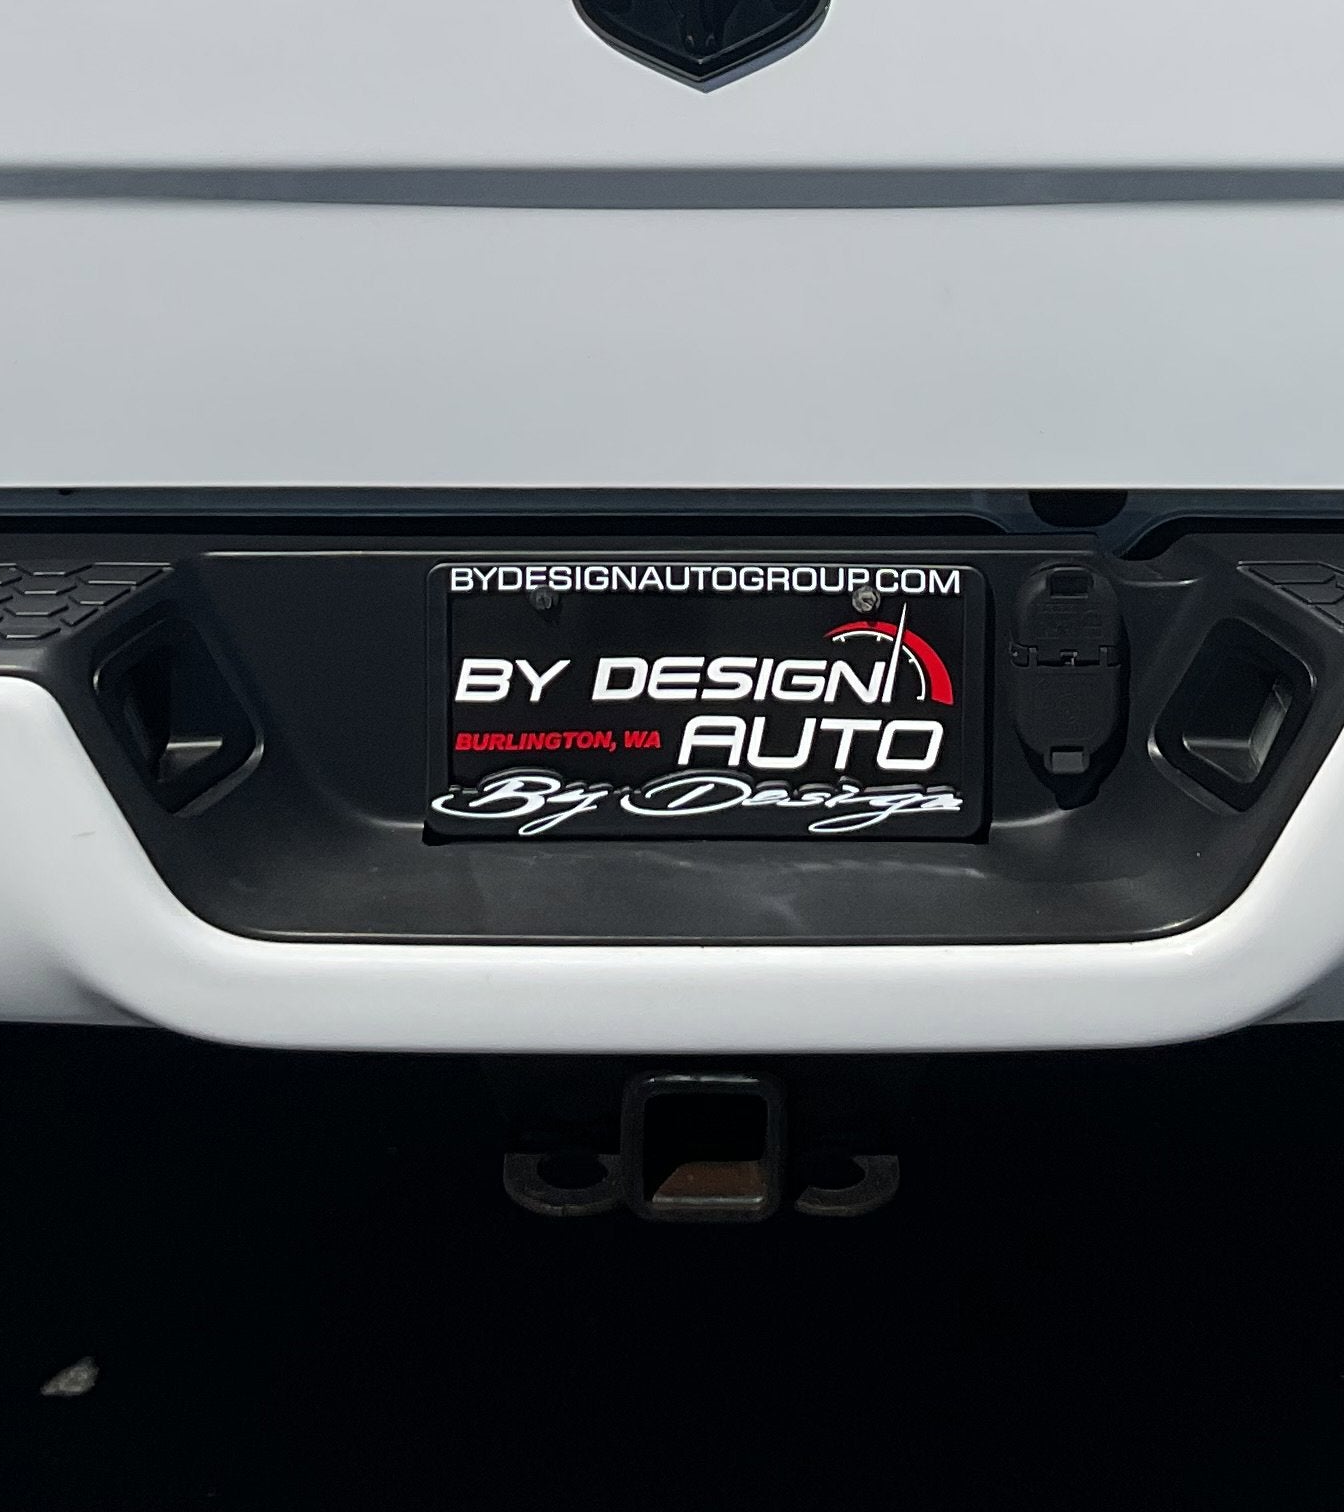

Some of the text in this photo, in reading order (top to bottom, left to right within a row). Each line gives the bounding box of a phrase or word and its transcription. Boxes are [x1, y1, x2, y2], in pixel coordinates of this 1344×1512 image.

[450, 566, 961, 594] BYDESIGNAUTOGROUPCOM
[455, 656, 887, 704] BY DESIGN
[455, 730, 662, 753] BURLINGTON, WA
[677, 715, 945, 772] AUTO
[432, 773, 964, 837] By Design
